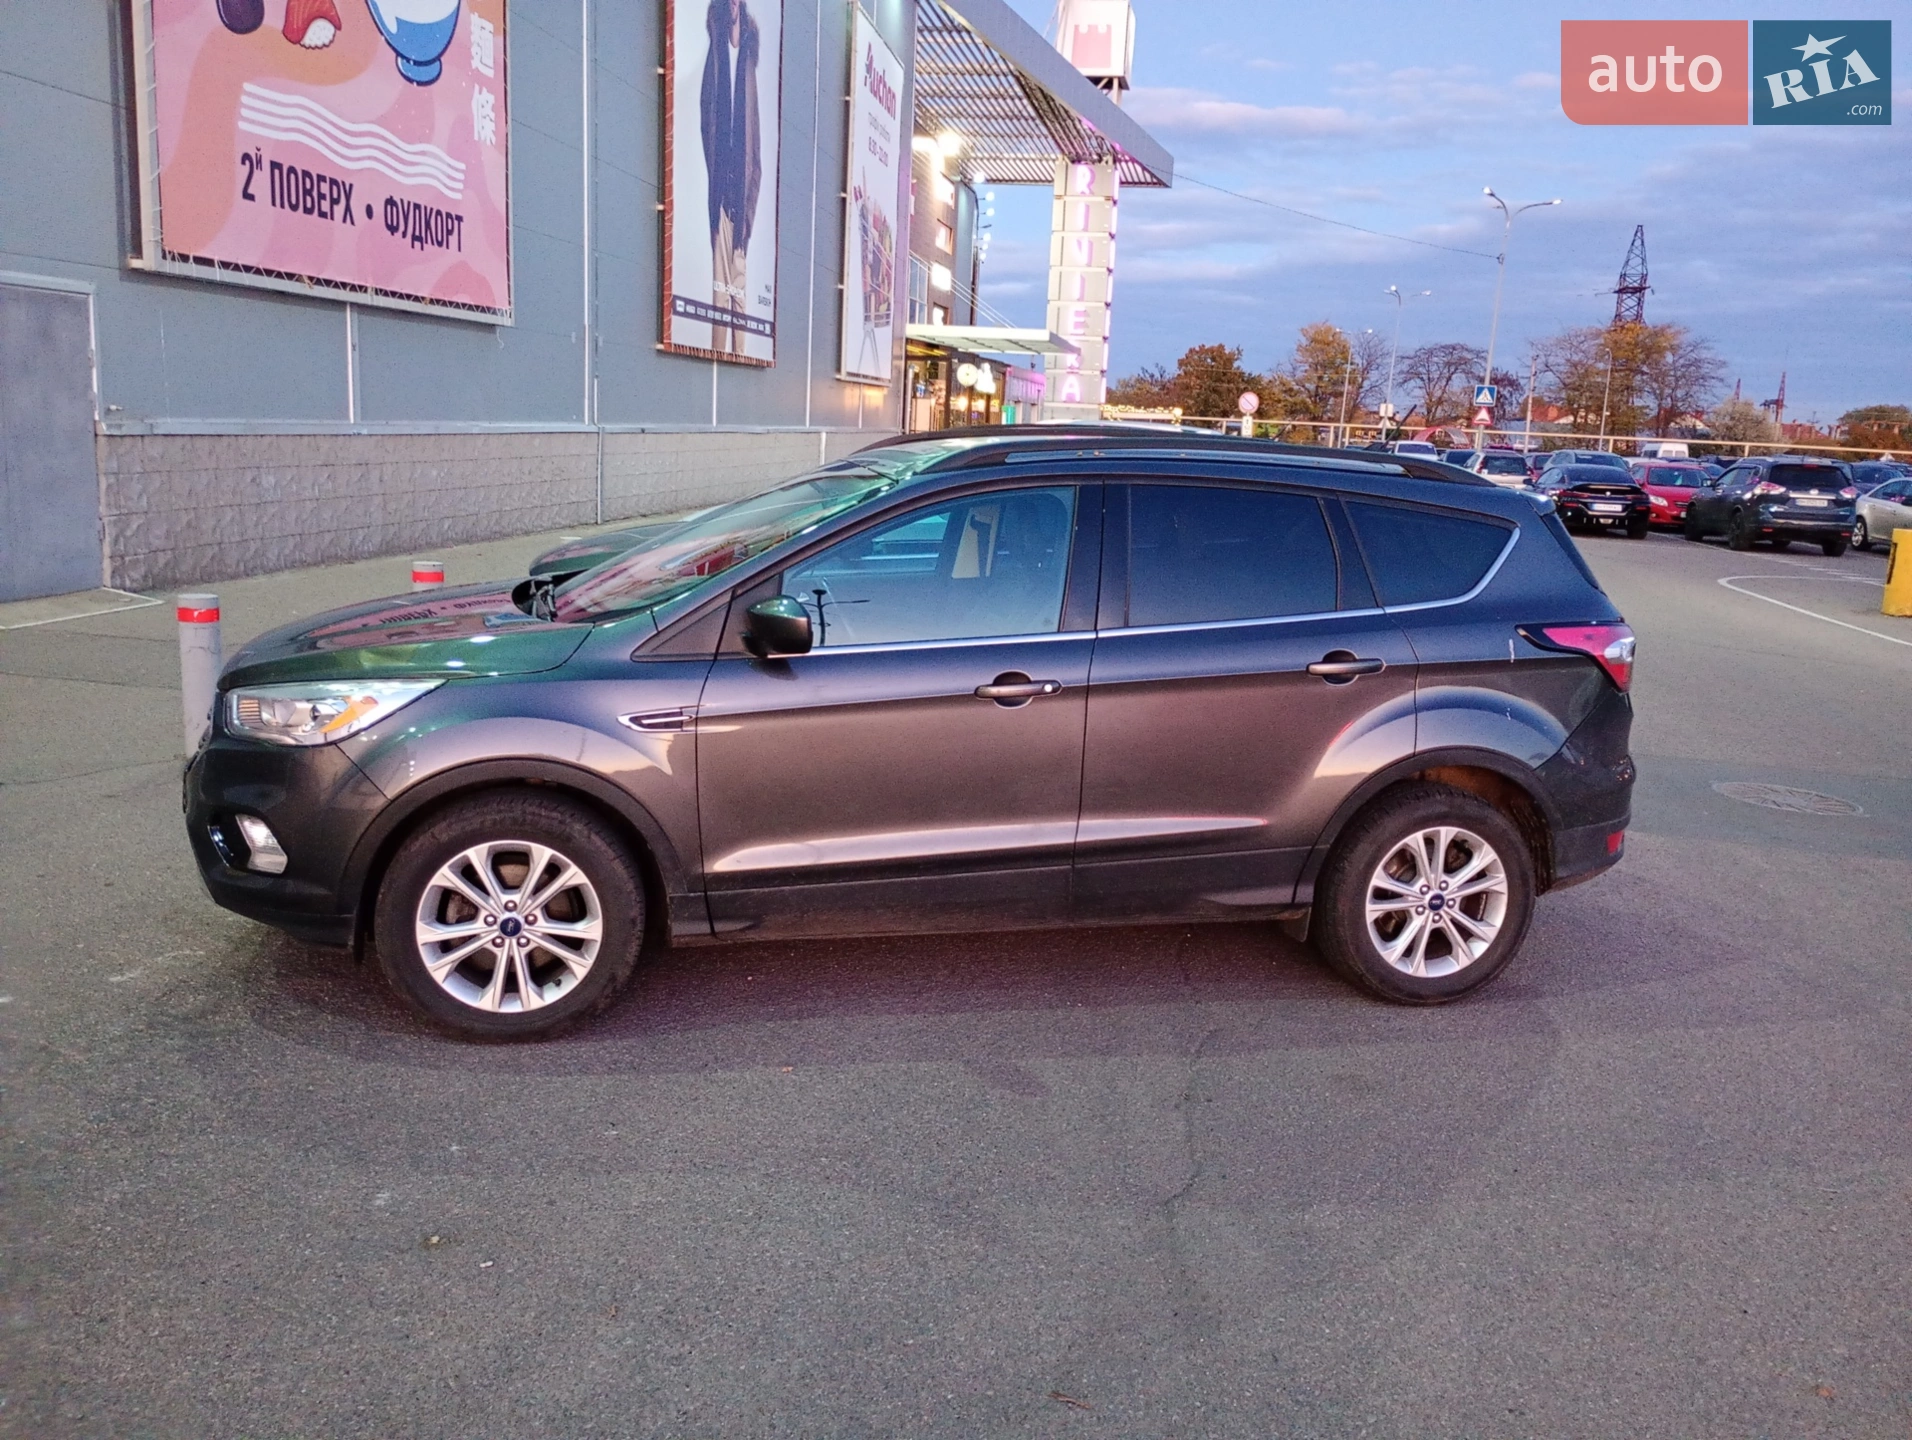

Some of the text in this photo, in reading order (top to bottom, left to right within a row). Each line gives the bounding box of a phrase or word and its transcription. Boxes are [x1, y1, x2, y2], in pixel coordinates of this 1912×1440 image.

[864, 42, 896, 121] Auchan
[269, 159, 355, 226] ПОВЕРХ
[384, 195, 464, 252] ФУДКОРТ
